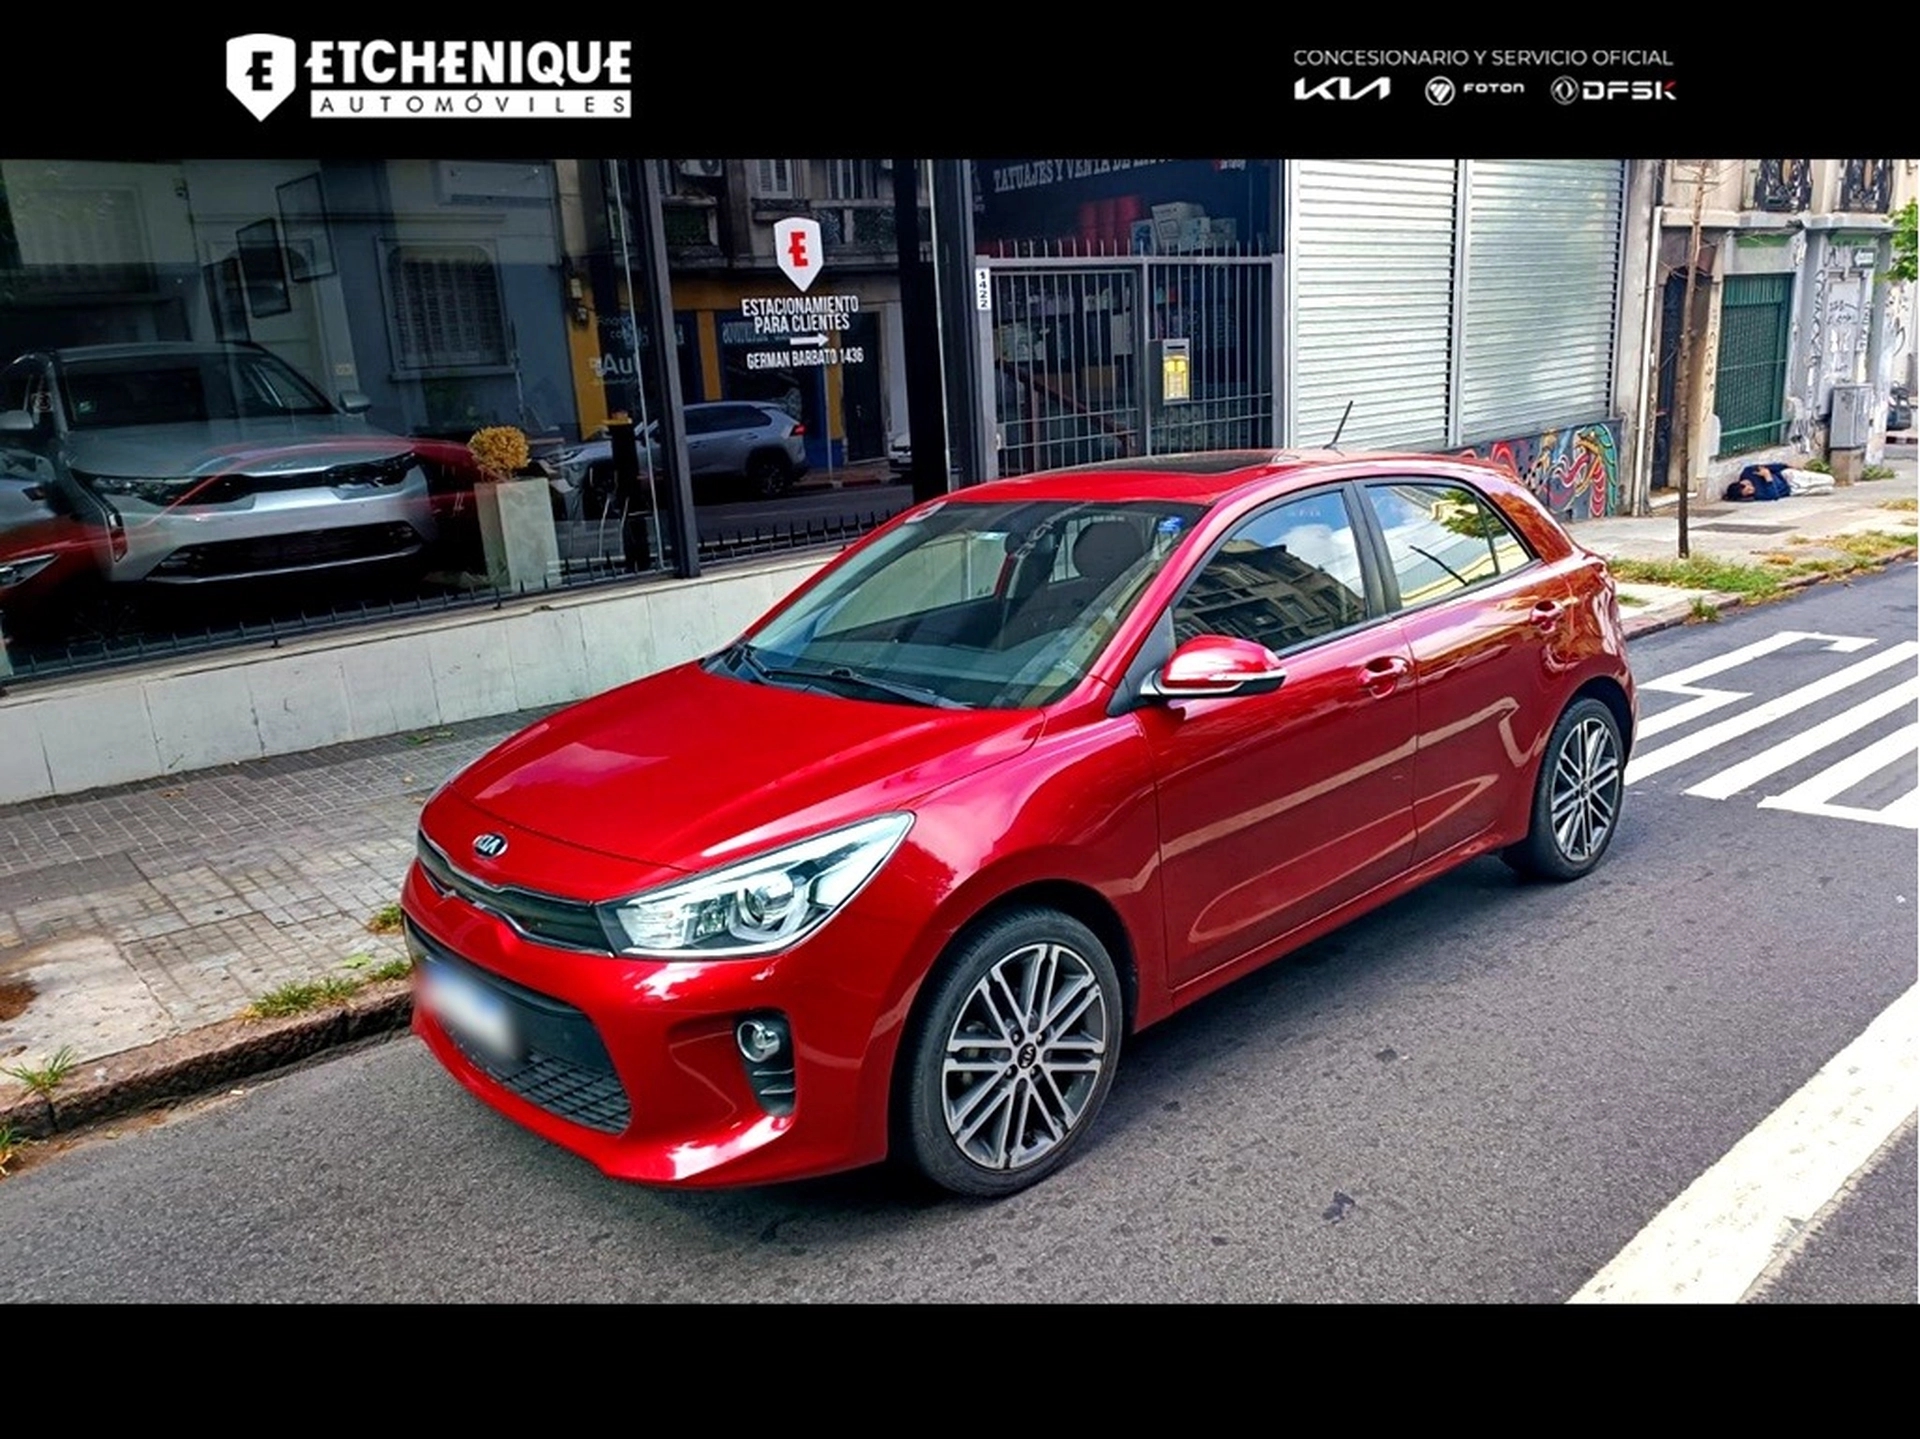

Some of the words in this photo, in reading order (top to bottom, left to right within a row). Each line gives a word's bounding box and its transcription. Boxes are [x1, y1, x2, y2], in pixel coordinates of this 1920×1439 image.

[993, 160, 1053, 193] TATUAJES
[1054, 160, 1063, 181] Y
[979, 271, 988, 308] 1422
[741, 295, 860, 317] ESTACIONAMIENTO
[754, 315, 789, 334] PARA
[791, 313, 850, 332] CLIENTES
[746, 351, 790, 370] GERMAN
[791, 347, 838, 367] BARBATO
[840, 346, 864, 363] 1436
